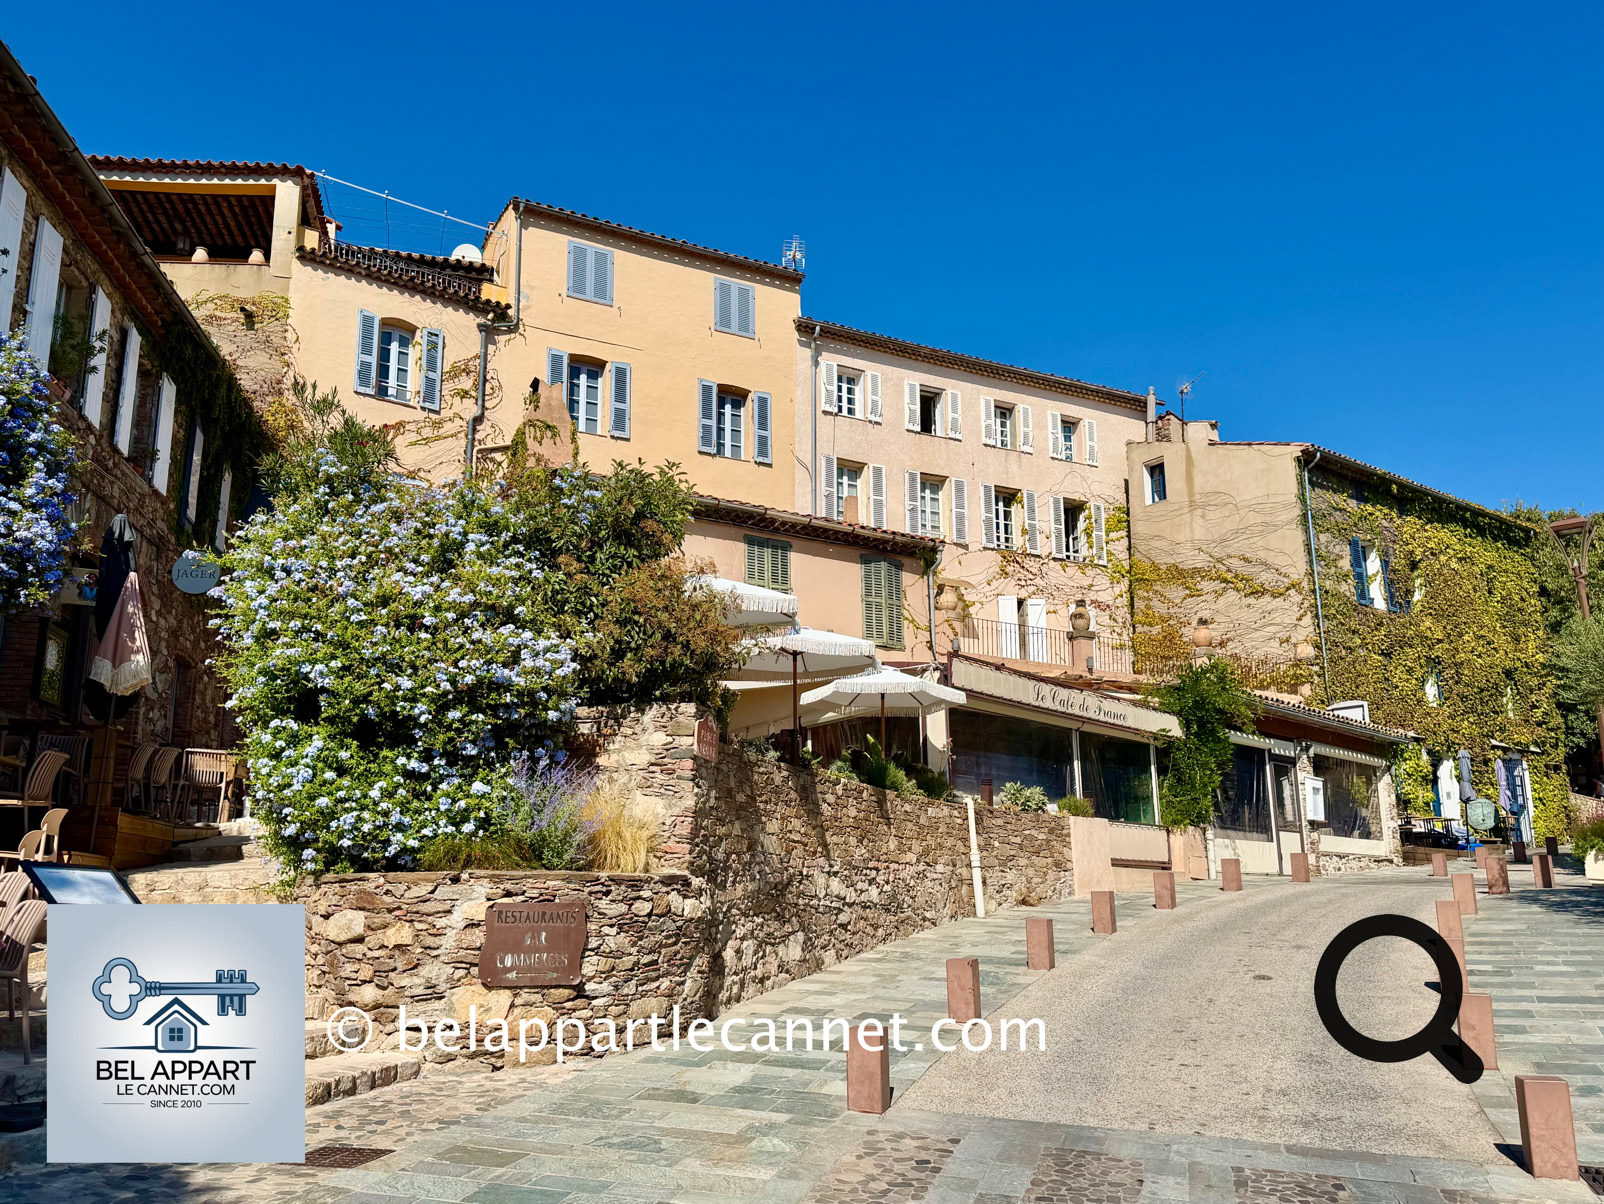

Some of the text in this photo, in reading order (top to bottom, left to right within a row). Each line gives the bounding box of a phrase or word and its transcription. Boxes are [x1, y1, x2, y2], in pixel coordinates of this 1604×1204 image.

[175, 569, 216, 580] JAGER
[1033, 684, 1128, 722] Le Café de France
[701, 729, 717, 744] PLACE
[496, 909, 578, 925] RESTAURANTS
[525, 931, 547, 945] BAR
[496, 952, 568, 968] COMMERCES
